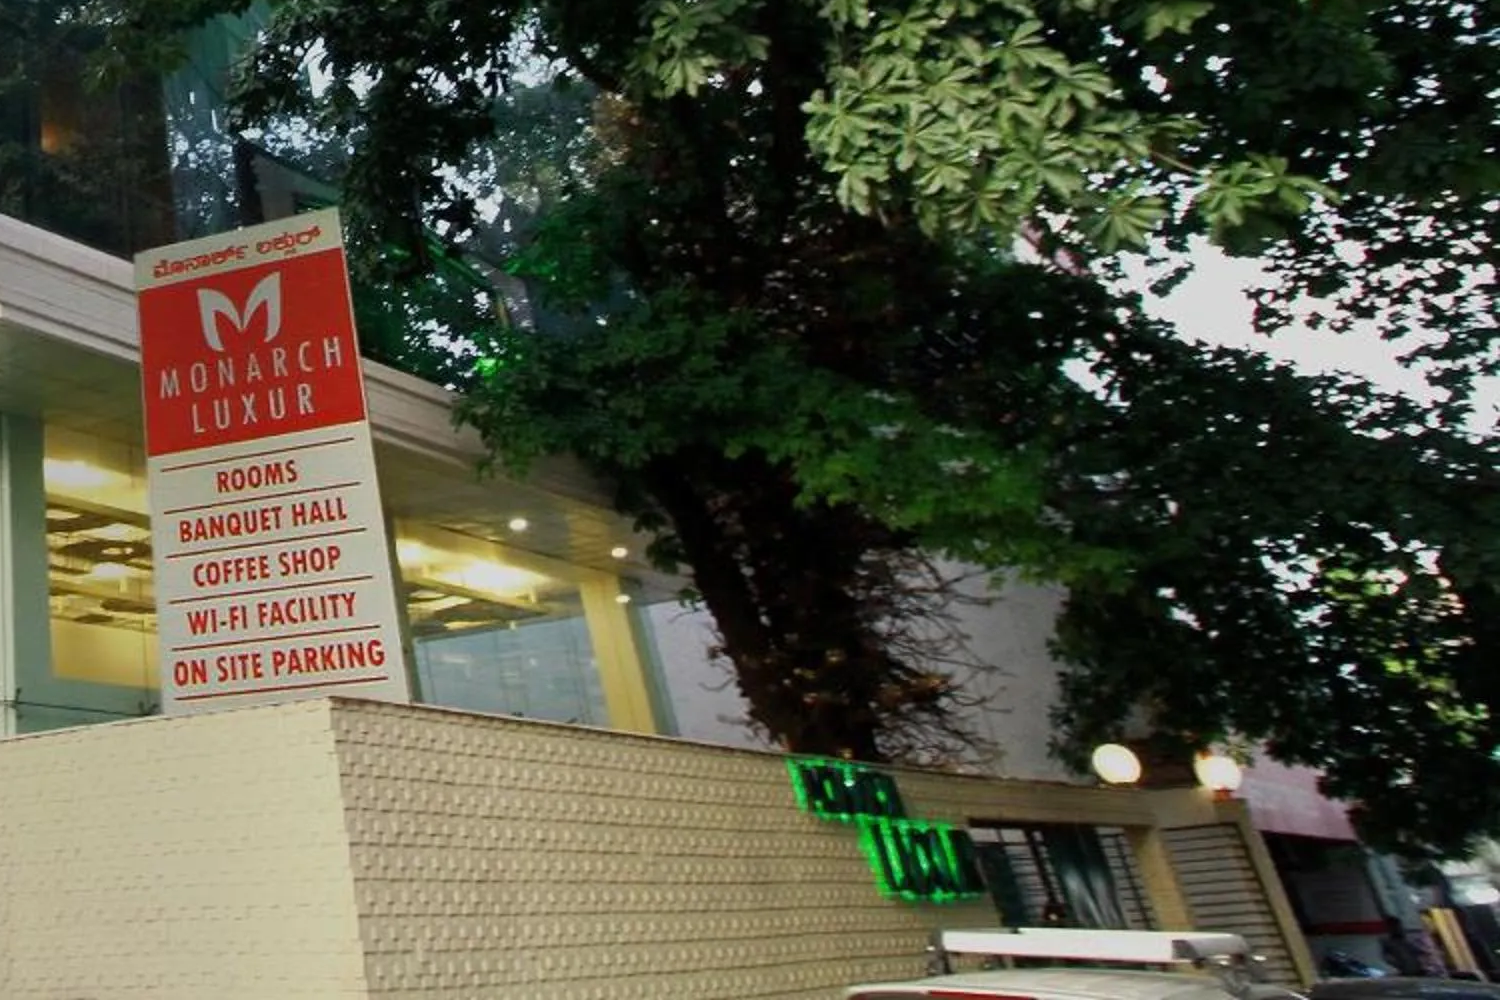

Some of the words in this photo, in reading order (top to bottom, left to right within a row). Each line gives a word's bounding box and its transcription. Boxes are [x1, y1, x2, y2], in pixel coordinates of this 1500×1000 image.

[159, 336, 343, 399] MONARCH
[191, 383, 314, 434] LUXUR
[216, 460, 298, 493] ROOMS
[179, 506, 282, 543] BANQUET
[291, 497, 348, 526] HALL
[192, 555, 269, 587] COFFEE
[279, 545, 341, 577] SHOP
[186, 606, 248, 635] WI-FI
[257, 592, 356, 628] FACILITY
[173, 660, 207, 686] ON
[217, 653, 263, 683] SITE
[271, 639, 385, 677] PARKING
